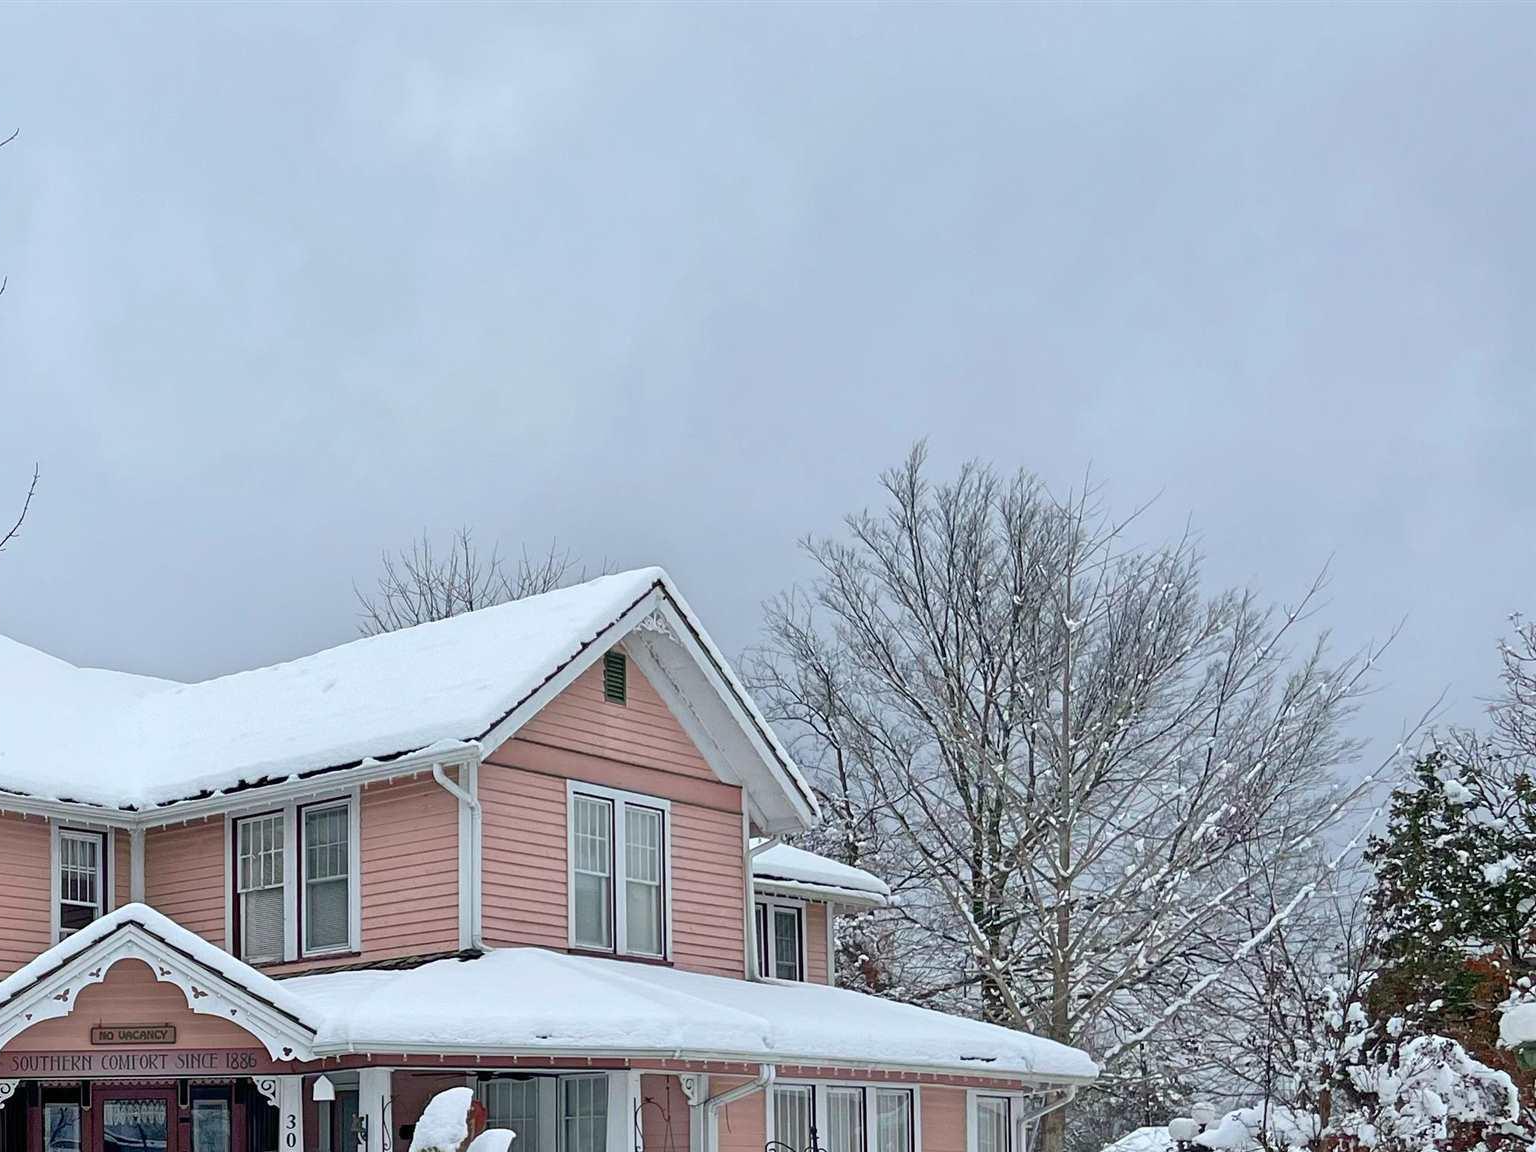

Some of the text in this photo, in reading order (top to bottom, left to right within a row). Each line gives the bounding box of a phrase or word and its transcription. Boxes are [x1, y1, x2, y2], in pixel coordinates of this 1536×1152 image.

[99, 1029, 168, 1041] NO VACANCY
[12, 1052, 257, 1072] SOUTHERN COMFORT SINCE 1886
